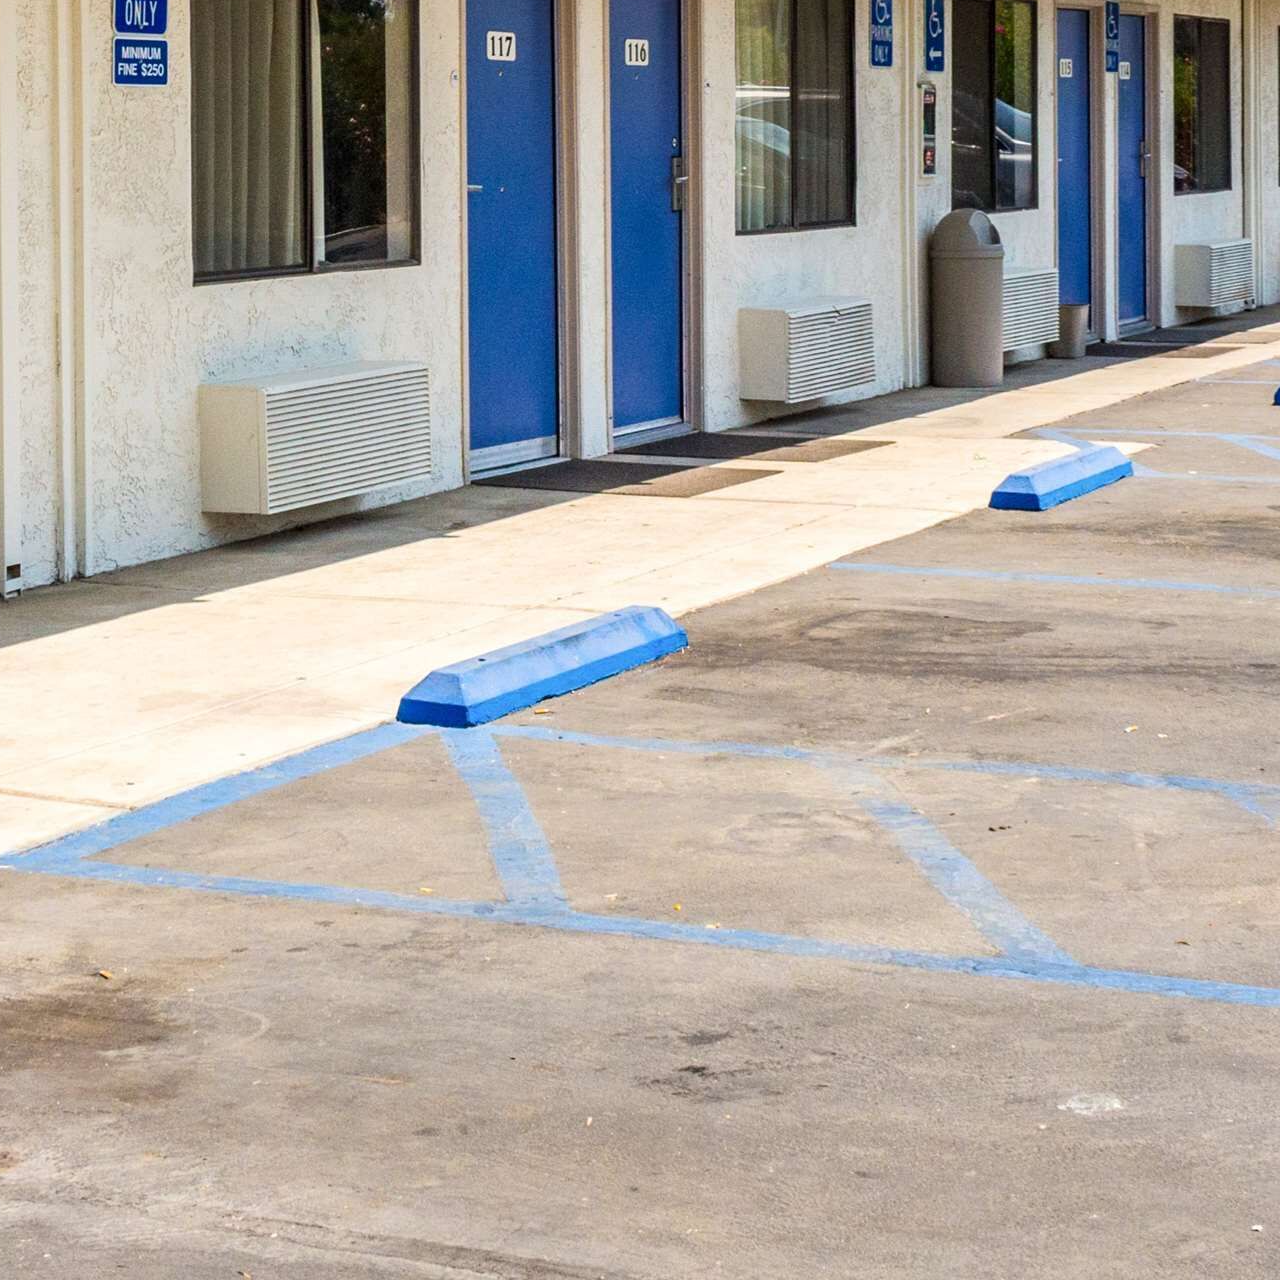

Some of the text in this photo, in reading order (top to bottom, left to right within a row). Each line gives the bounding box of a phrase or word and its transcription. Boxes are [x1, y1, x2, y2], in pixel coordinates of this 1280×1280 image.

[125, 0, 158, 26] ONLY
[122, 46, 161, 59] MINIMUM
[490, 35, 513, 57] 117
[628, 43, 647, 62] 116
[118, 63, 164, 77] FINE $250
[1061, 61, 1072, 76] 115
